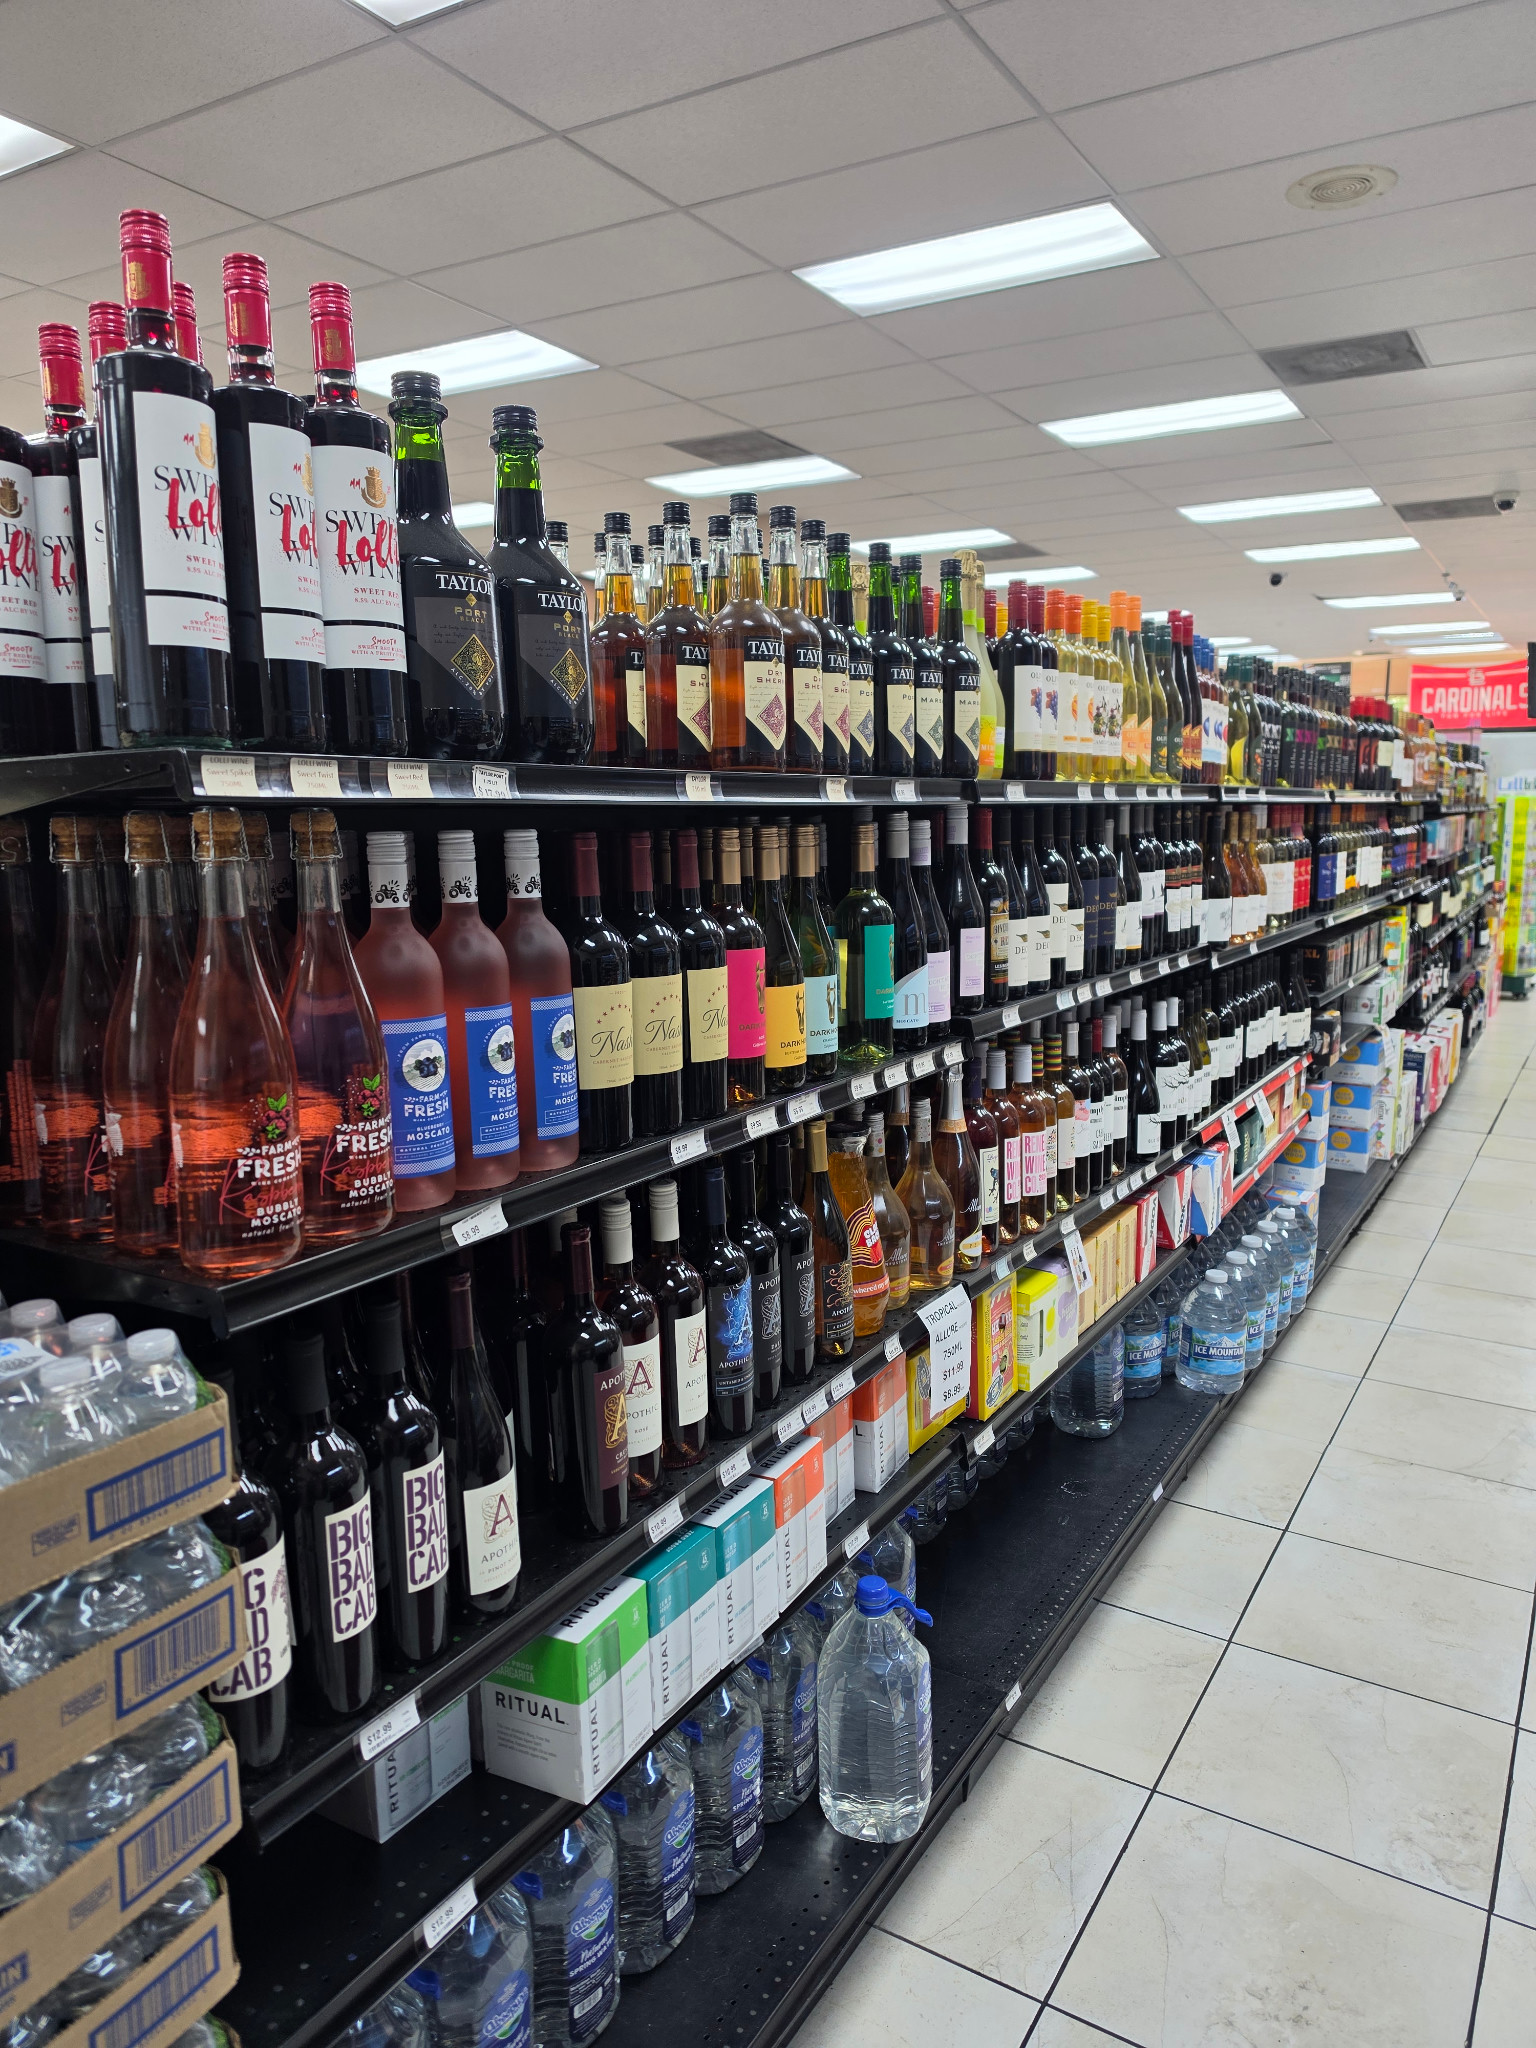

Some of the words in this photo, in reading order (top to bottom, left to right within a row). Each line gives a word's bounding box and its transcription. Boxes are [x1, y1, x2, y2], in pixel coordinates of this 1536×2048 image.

[354, 587, 385, 596] SWEET
[454, 606, 487, 619] PORT
[554, 622, 582, 633] PORT
[318, 771, 334, 779] Twist
[739, 1022, 760, 1031] DARK
[810, 1027, 830, 1037] DARK
[780, 1040, 801, 1049] DARK
[404, 1096, 449, 1118] FRESH
[419, 1092, 440, 1103] FARM
[358, 1119, 385, 1132] FARM
[406, 1125, 451, 1142] MOSCATO
[416, 1122, 445, 1132] BLUEBERRY
[335, 1123, 393, 1153] FRESH
[1024, 1134, 1045, 1154] RENE
[261, 1142, 292, 1156] FARM
[236, 1150, 302, 1179] FRESH
[1024, 1153, 1046, 1174] WINE
[354, 1171, 391, 1187] BUBBLY
[256, 1197, 299, 1217] BUBBLY
[340, 1198, 371, 1209] natural
[241, 1227, 275, 1239] natural
[925, 1300, 958, 1326] TROPICAL
[935, 1321, 959, 1344] ALLURE
[1172, 1329, 1181, 1340] ICE
[1250, 1325, 1260, 1335] ICE
[942, 1341, 963, 1361] 750ML
[1129, 1351, 1142, 1361] ICE
[1195, 1345, 1208, 1354] ICE
[719, 1355, 750, 1369] APOTHIC
[943, 1360, 964, 1381] $11.99
[405, 1462, 444, 1515] BIG
[702, 1482, 750, 1516] RITUAL
[328, 1503, 371, 1561] BIG
[407, 1497, 446, 1552] BAD
[408, 1533, 448, 1586] CAB
[331, 1540, 374, 1600] BAD
[333, 1582, 377, 1636] CAB
[560, 1583, 619, 1629] RITUAL
[727, 1576, 735, 1646] RITUAL
[662, 1632, 671, 1706] RITUAL
[494, 1690, 567, 1726] RITUAL
[366, 1720, 393, 1747] $12.99
[592, 1698, 601, 1776] RITUAL
[732, 1794, 753, 1812] SPRING
[662, 1862, 685, 1883] SPRING
[569, 1956, 598, 1978] SPRING
